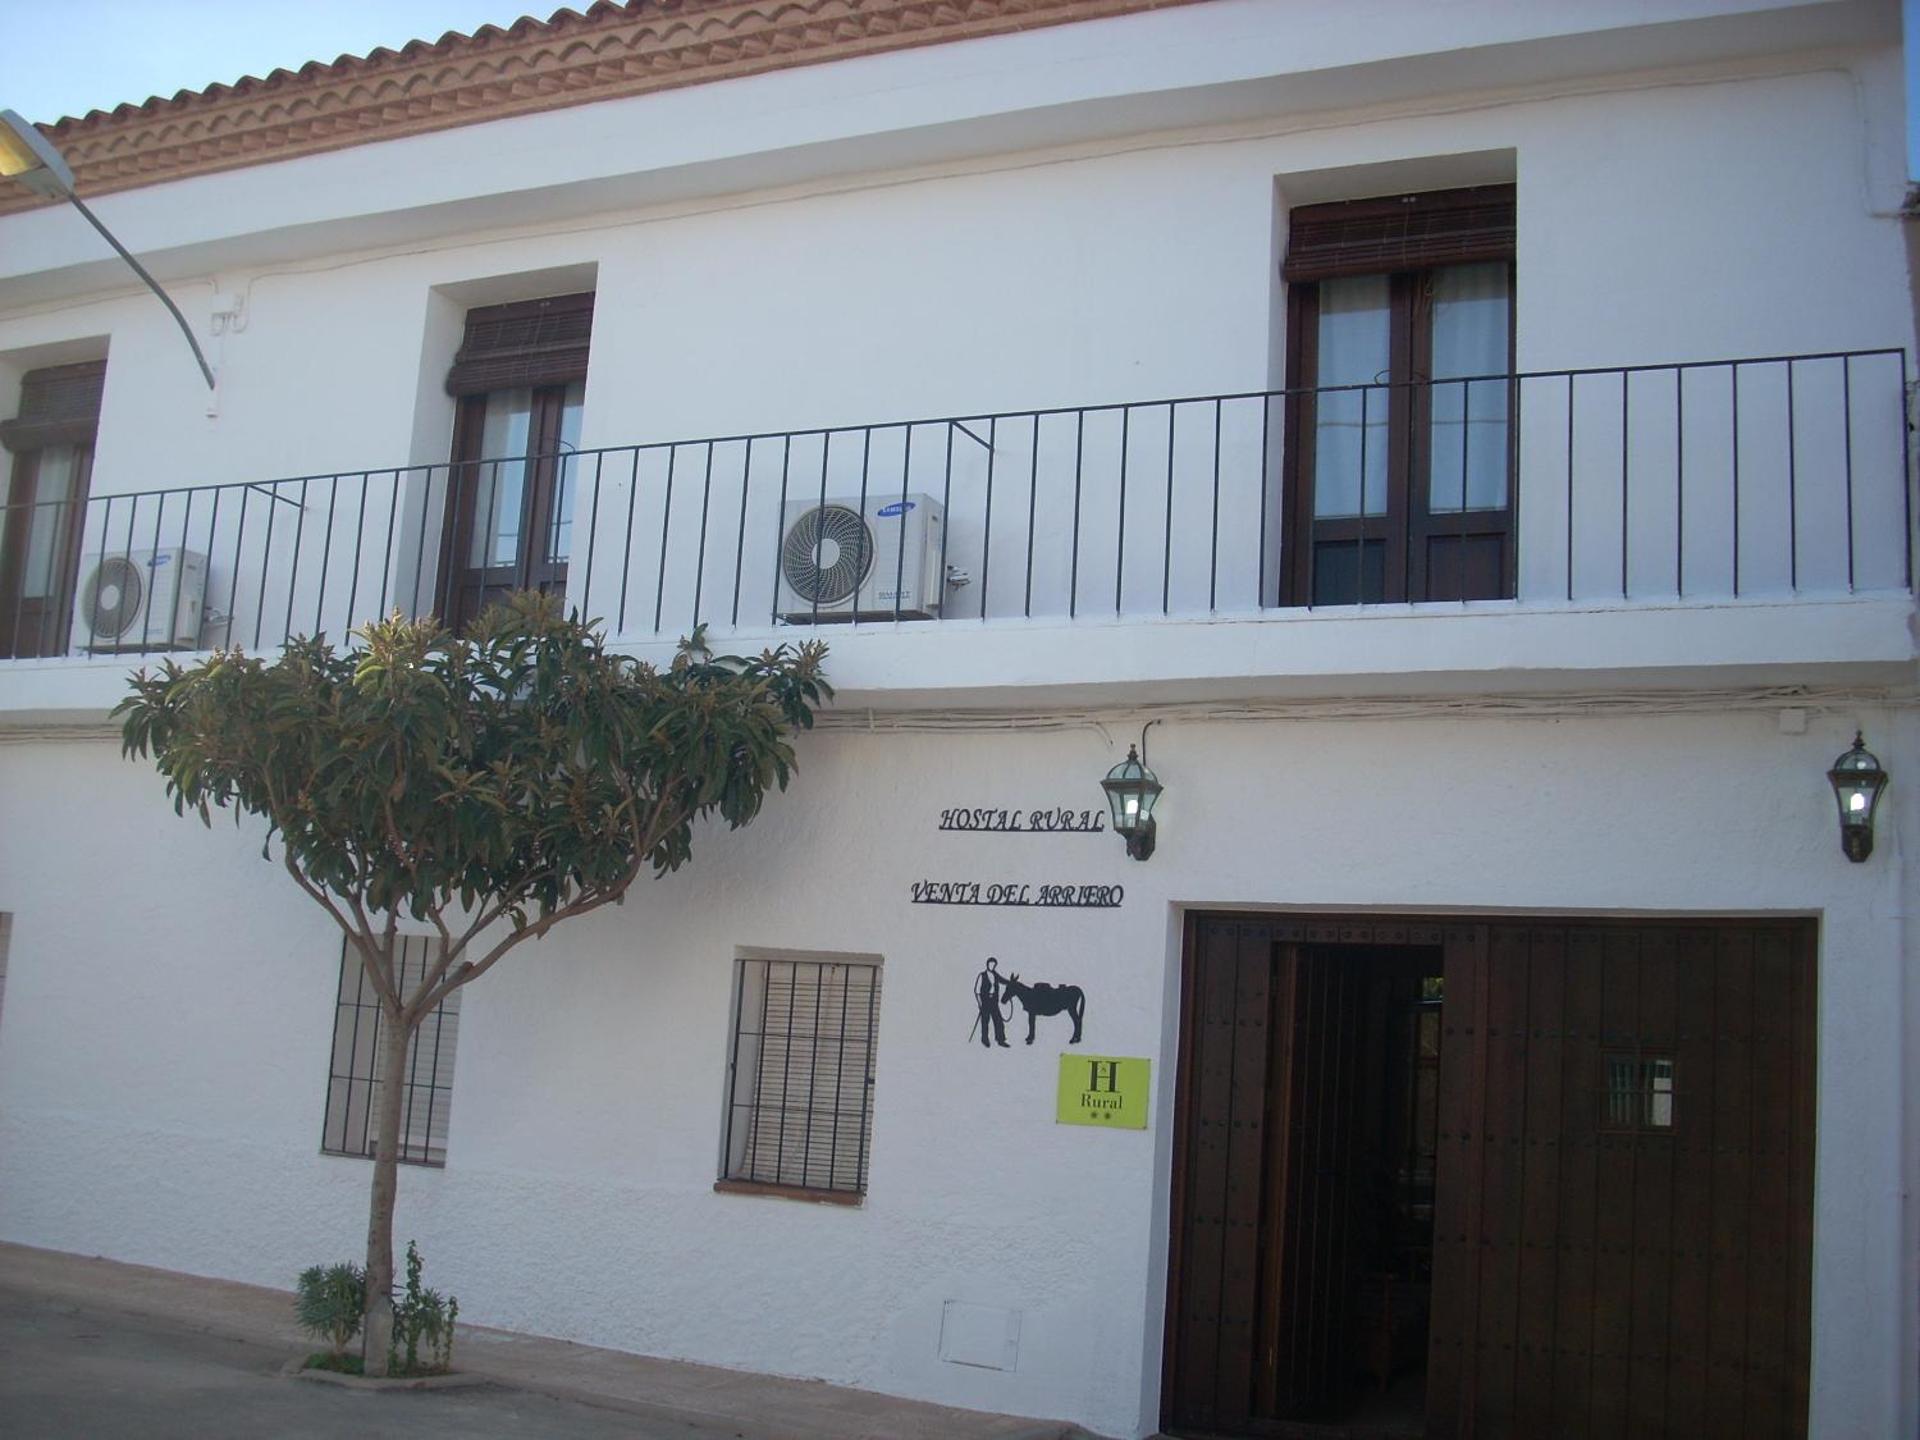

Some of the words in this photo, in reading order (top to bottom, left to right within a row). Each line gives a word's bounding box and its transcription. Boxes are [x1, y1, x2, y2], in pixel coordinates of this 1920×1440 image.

[939, 808, 1022, 831] HOSTAL
[1029, 806, 1105, 832] RURAL
[910, 879, 981, 904] VENTA
[986, 884, 1030, 906] DEL
[1034, 884, 1124, 907] ARRIERO
[1086, 1060, 1122, 1093] H
[1081, 1093, 1122, 1109] Rural
